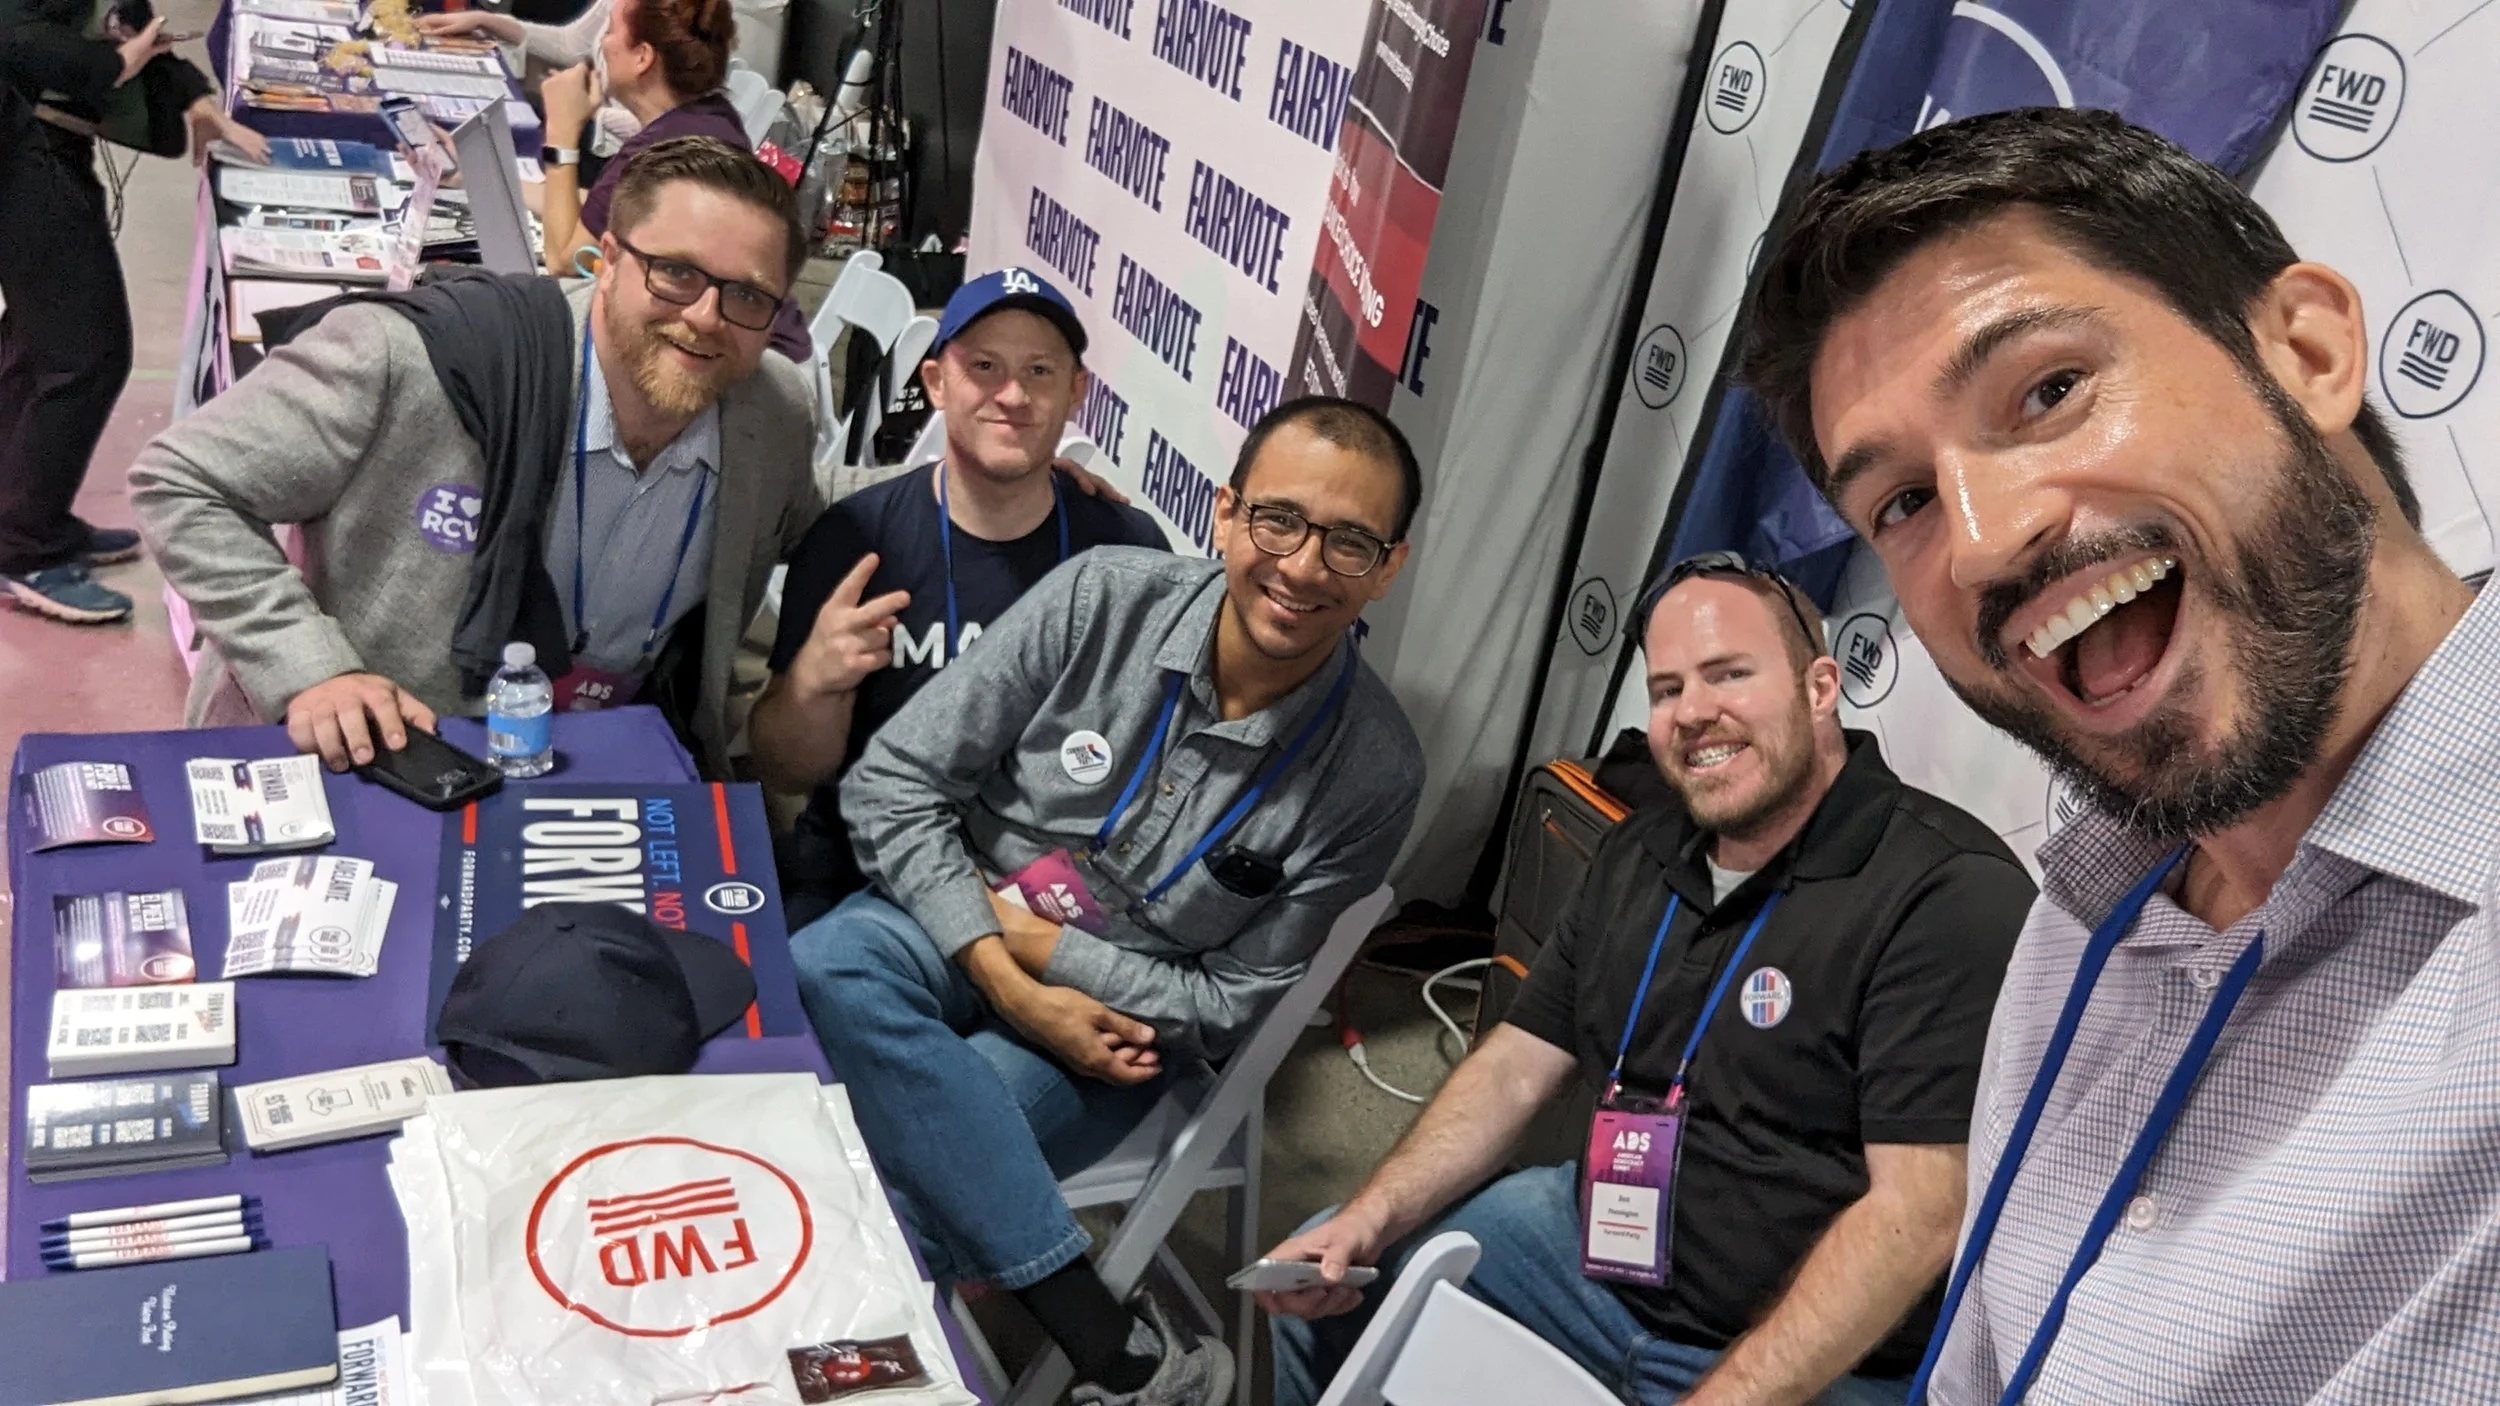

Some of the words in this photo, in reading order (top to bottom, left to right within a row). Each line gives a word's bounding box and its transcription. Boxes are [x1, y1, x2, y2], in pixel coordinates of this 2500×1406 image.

[1153, 0, 1253, 103] FAIRVOTE
[1002, 46, 1074, 147] FAIRVOTE
[1719, 64, 1753, 93] FWD
[2316, 64, 2386, 107] FWD
[1085, 95, 1171, 214] FAIRVOTE
[1026, 185, 1101, 299] FAIRVOTE
[1185, 159, 1291, 296] FAIRVOTE
[1002, 268, 1039, 294] LA
[1113, 252, 1202, 384] FAIRVOTE
[1648, 344, 1676, 373] FWD
[2406, 318, 2460, 365] FWD
[434, 489, 457, 514] I
[422, 509, 479, 542] RCV
[1583, 594, 1606, 624] FWD
[1851, 632, 1883, 670] FWD
[576, 680, 614, 700] ADS
[645, 798, 675, 835] NOT
[650, 841, 681, 887] LEFT.
[456, 849, 476, 963] FORWARDPARTY.COM
[1049, 883, 1083, 919] ADS
[1613, 1130, 1652, 1152] ADS
[598, 1218, 759, 1287] FWD
